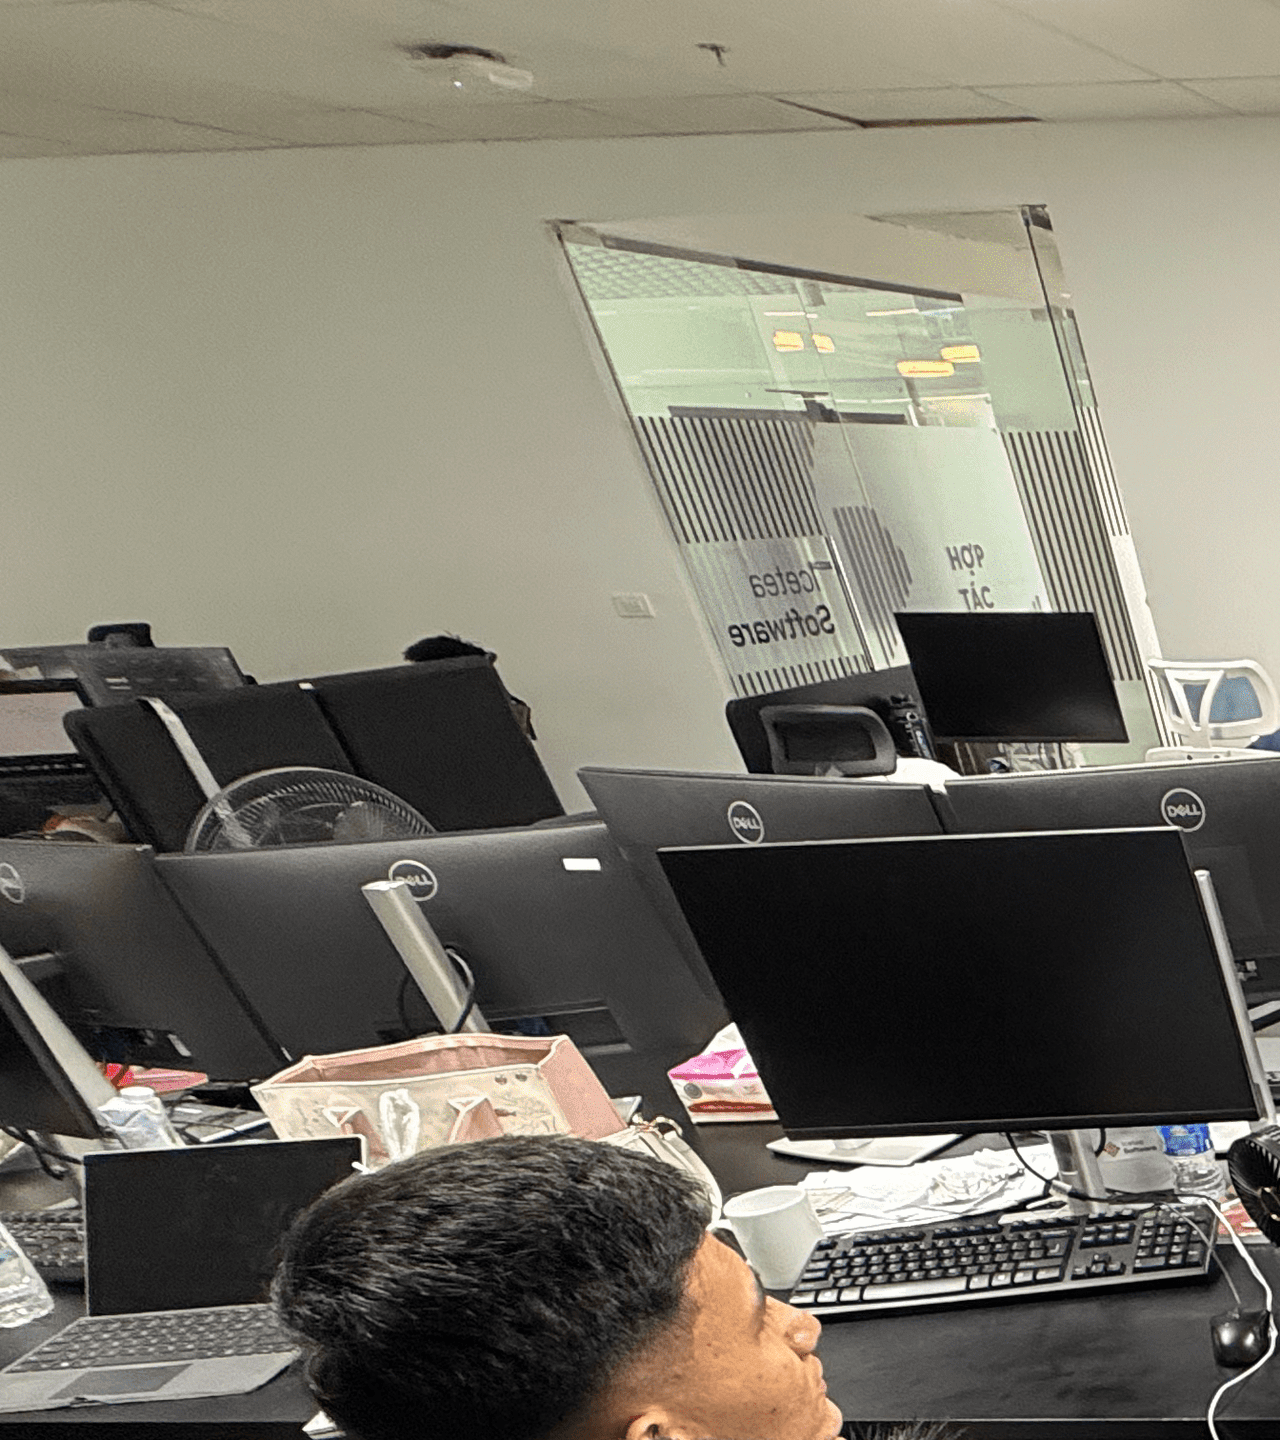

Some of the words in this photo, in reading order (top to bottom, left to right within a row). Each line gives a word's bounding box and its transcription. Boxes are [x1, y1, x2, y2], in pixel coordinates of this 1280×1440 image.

[945, 543, 985, 576] HỢP
[958, 580, 995, 610] TÁC
[1166, 803, 1202, 818] DELL
